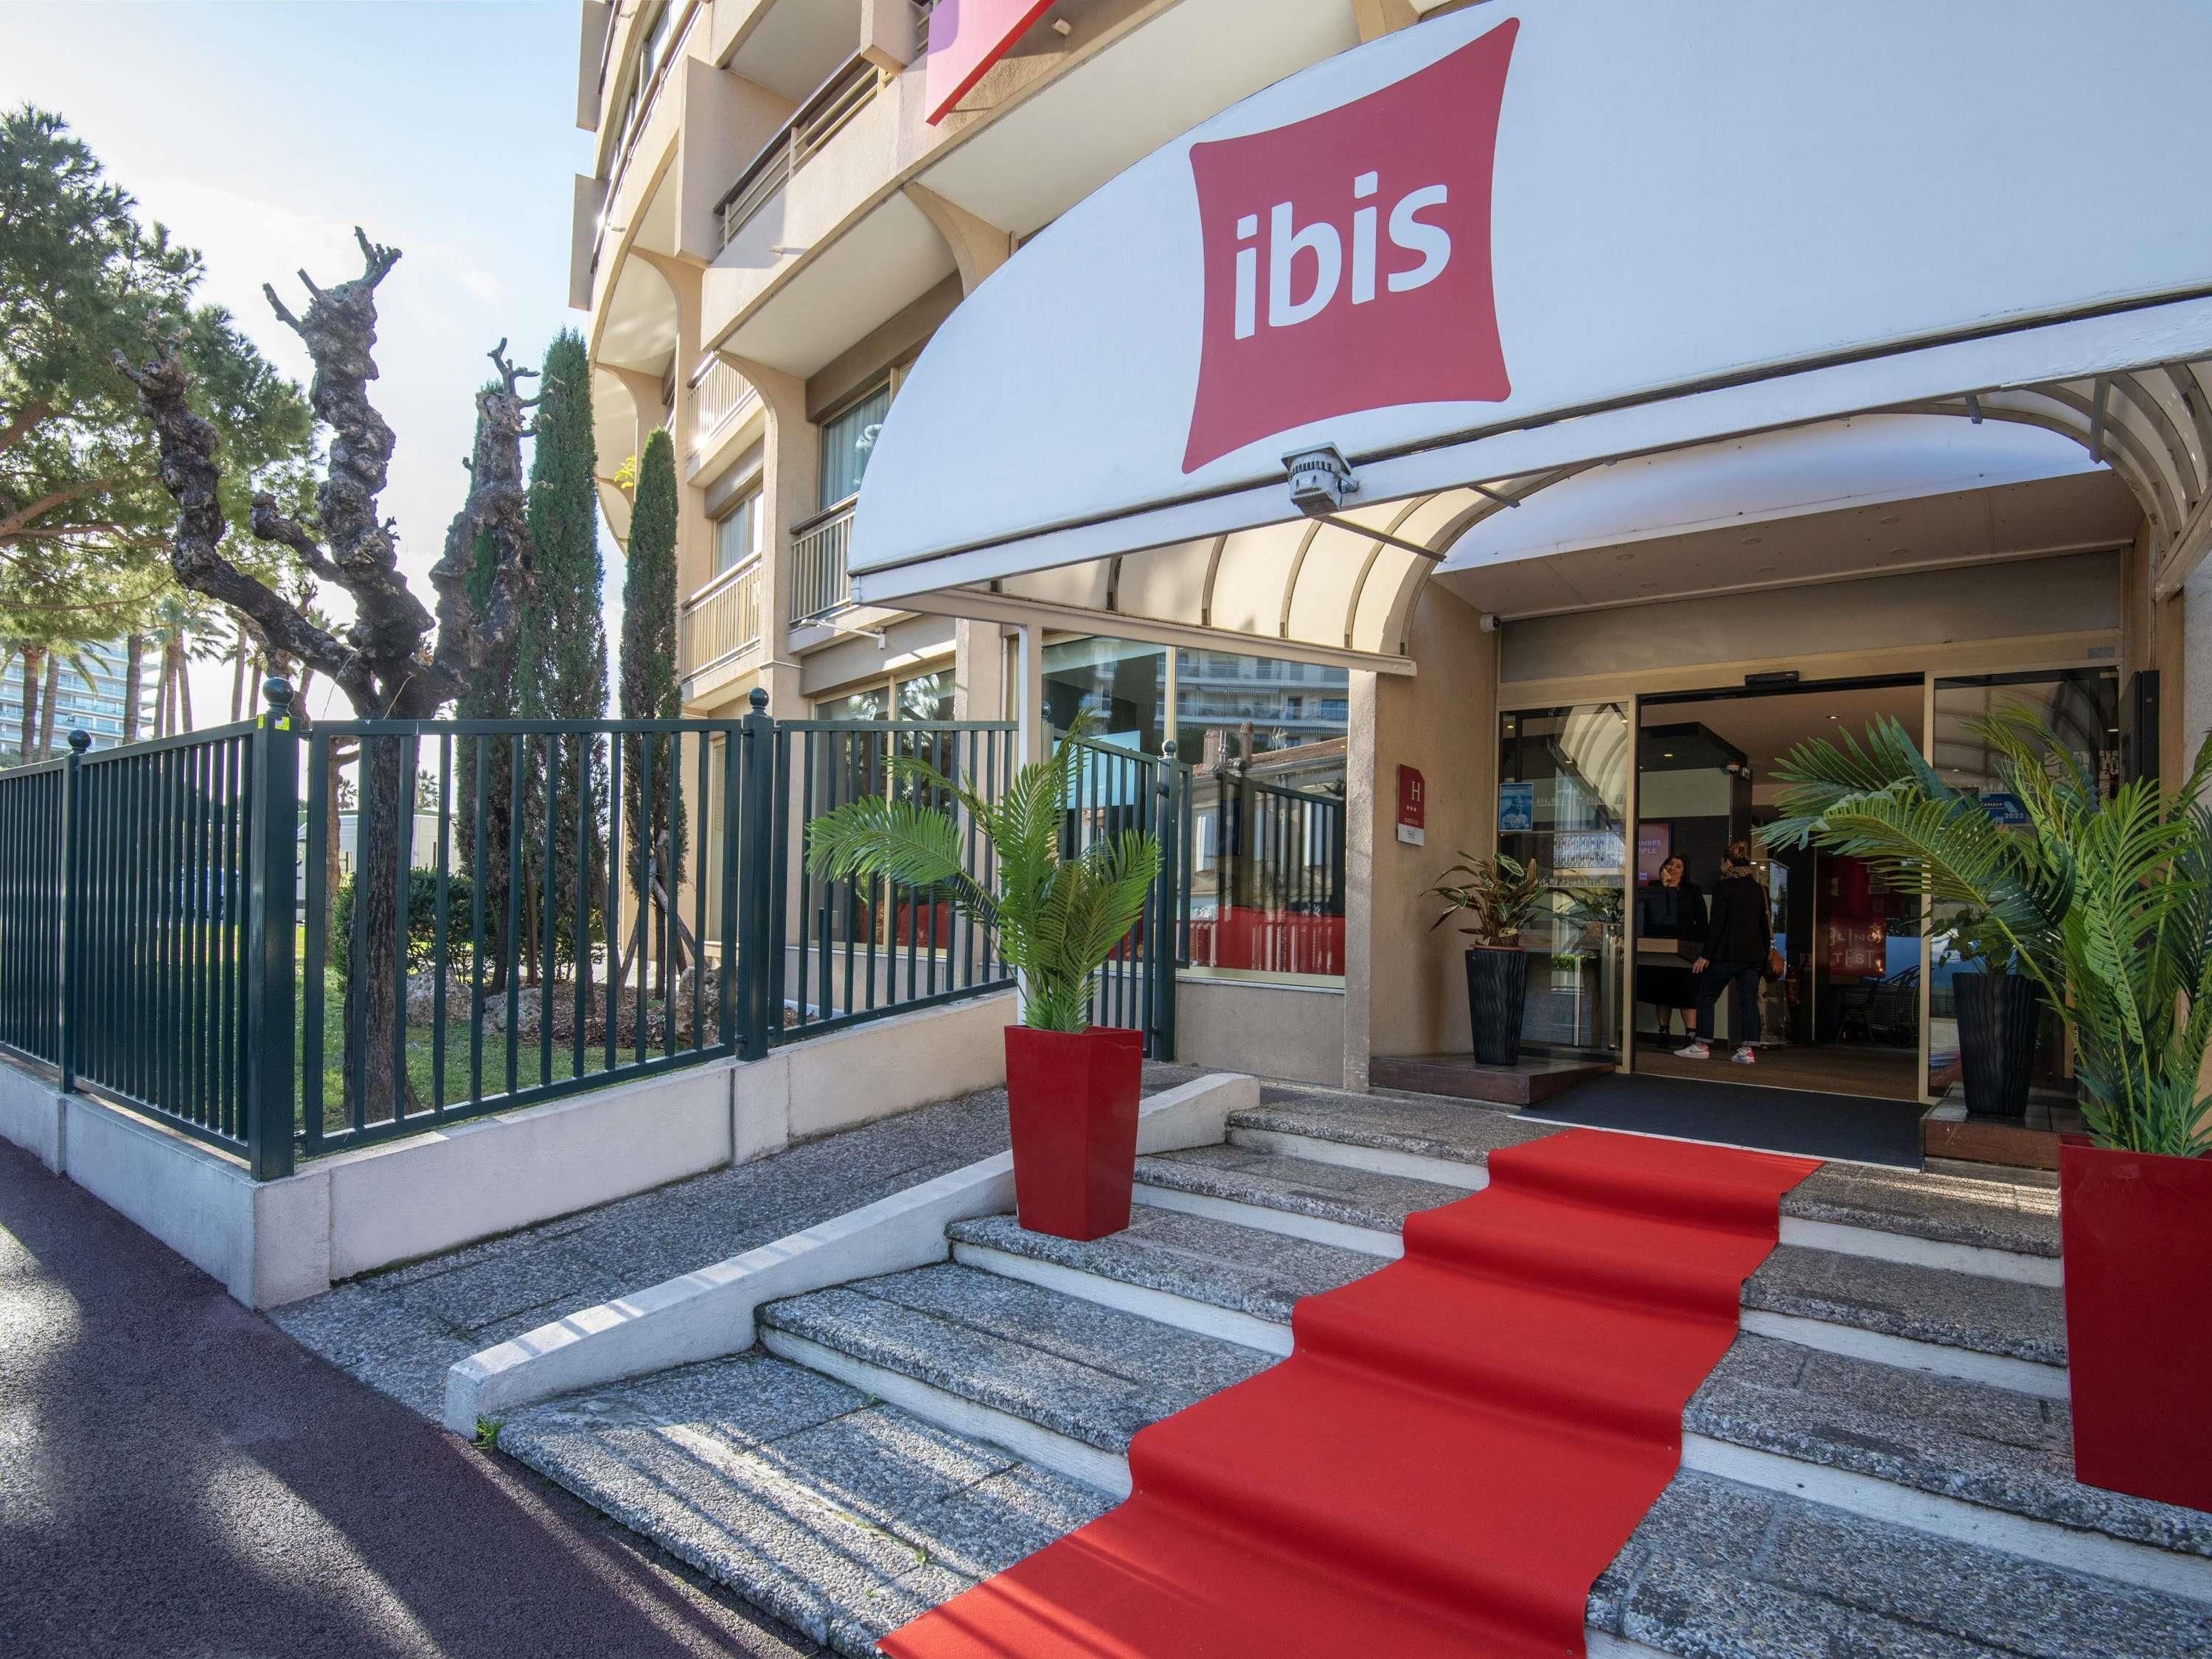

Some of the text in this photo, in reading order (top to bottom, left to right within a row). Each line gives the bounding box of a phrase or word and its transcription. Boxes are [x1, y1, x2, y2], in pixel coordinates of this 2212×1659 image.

[1234, 170, 1452, 340] ibis
[1410, 781, 1422, 802] H
[1832, 948, 1875, 969] TEST
